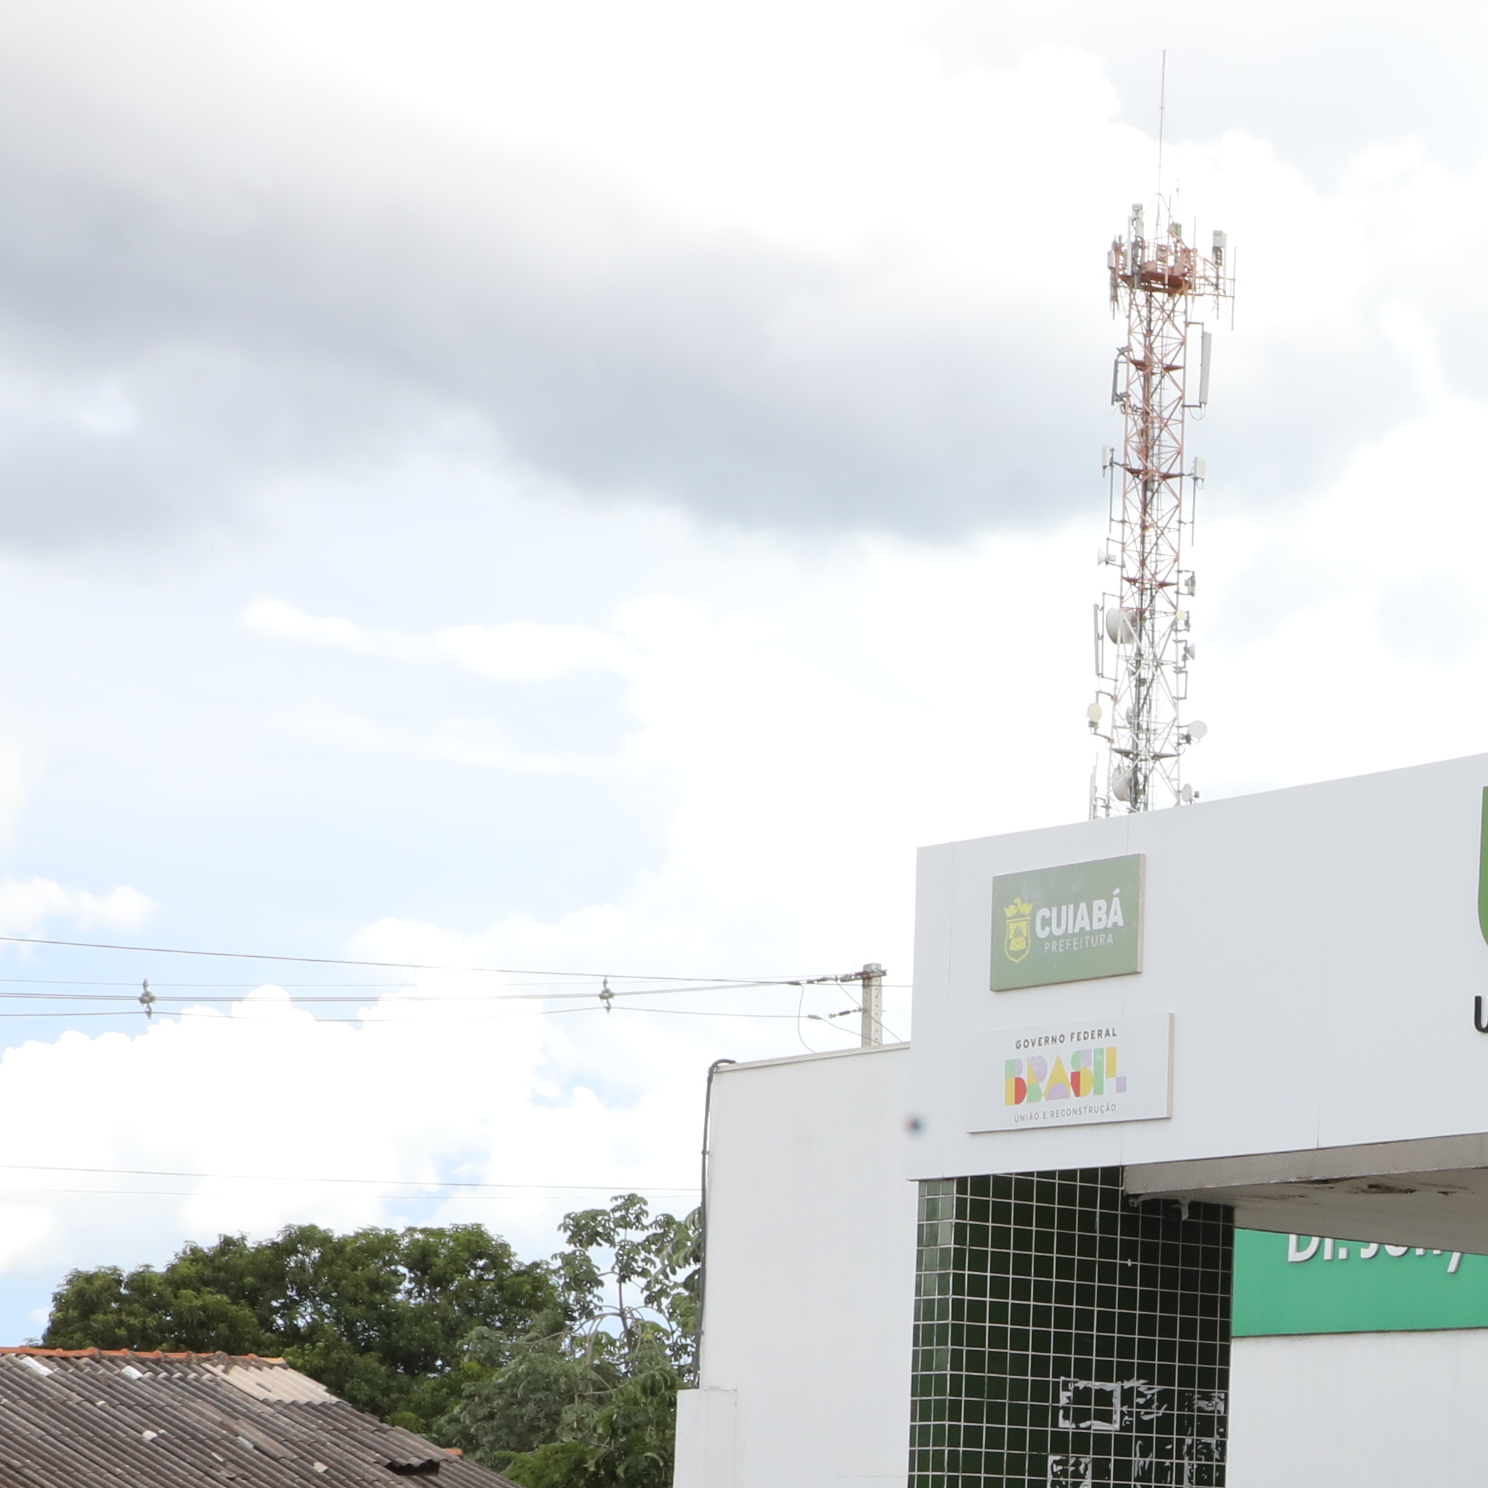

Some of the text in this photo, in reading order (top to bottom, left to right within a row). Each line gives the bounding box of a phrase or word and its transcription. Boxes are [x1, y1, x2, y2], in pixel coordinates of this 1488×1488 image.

[1034, 887, 1125, 939] CUIABÁ
[1043, 932, 1115, 955] PREFEITURA
[1015, 1027, 1118, 1050] GOVERNO FEDERAL
[1004, 1046, 1127, 1106] BRASIL
[1013, 1102, 1117, 1123] UNIÃO E RECONSTRUÇÃO
